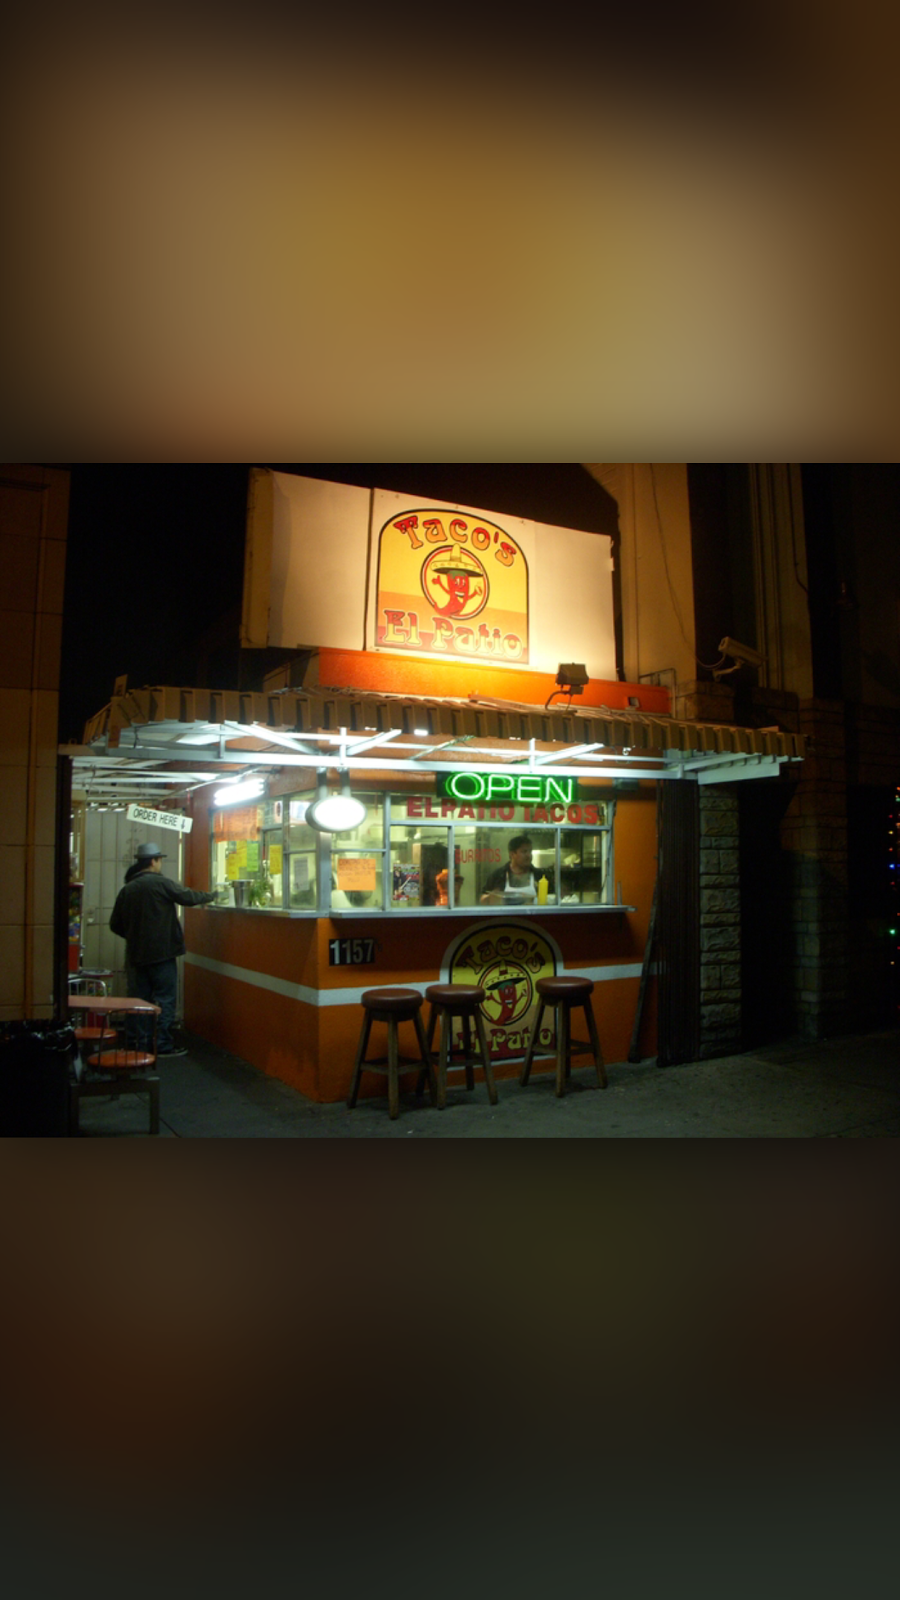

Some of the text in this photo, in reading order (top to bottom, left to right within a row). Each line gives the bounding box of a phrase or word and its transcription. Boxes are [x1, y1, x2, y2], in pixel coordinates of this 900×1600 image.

[393, 515, 517, 567] Taco's
[383, 609, 523, 658] El Patio
[449, 771, 574, 803] OPEN
[133, 808, 178, 827] ORDER HERE
[520, 801, 598, 824] TACOS
[455, 848, 501, 864] BURRITOS
[330, 939, 374, 965] 1157
[455, 936, 546, 975] Taco's
[490, 1027, 552, 1051] Pato
